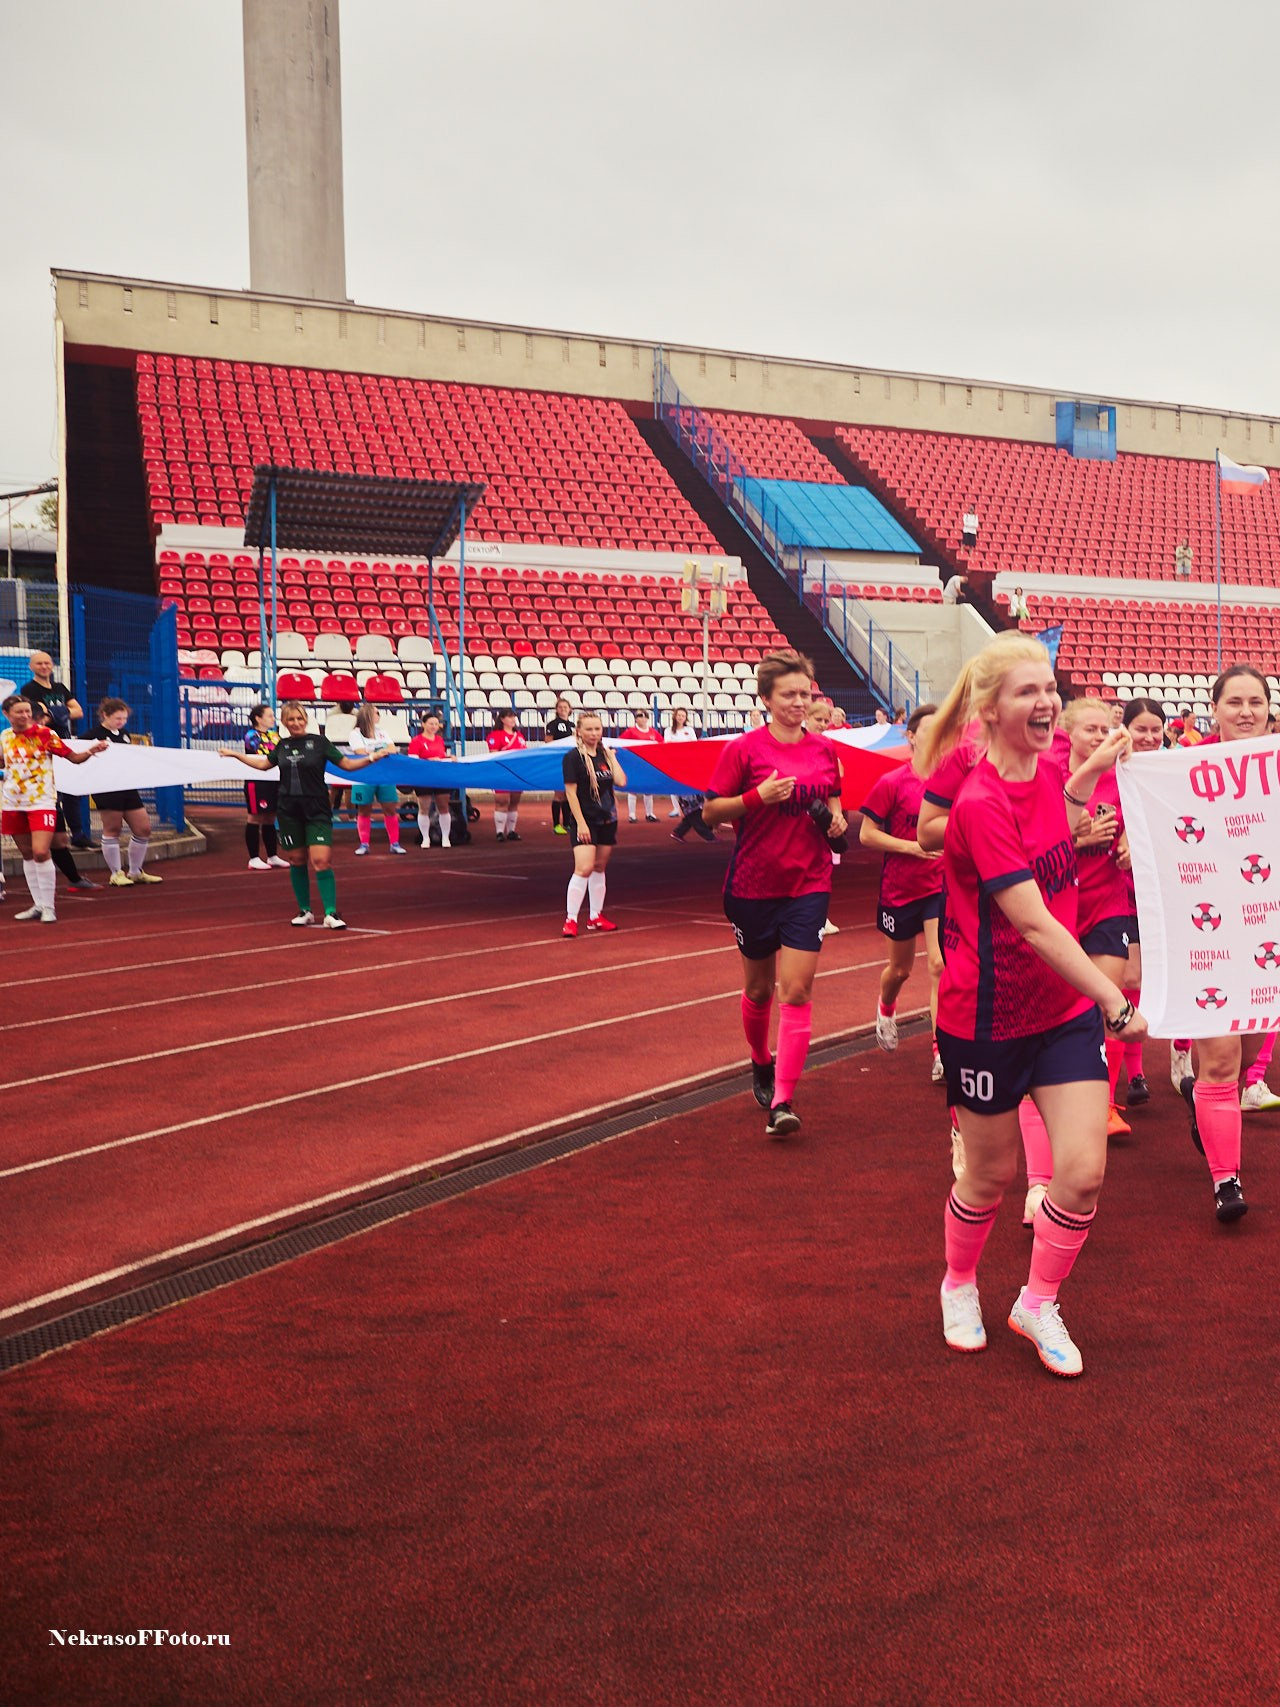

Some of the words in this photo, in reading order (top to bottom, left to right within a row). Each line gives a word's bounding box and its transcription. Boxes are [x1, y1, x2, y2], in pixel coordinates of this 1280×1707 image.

[1224, 812, 1267, 827] FOOTBALL
[1226, 826, 1250, 838] MOM!
[1177, 862, 1218, 874] FOOTBALL
[1180, 874, 1203, 885] MOM!
[882, 911, 896, 933] 88
[1243, 914, 1267, 926] MOM!
[1189, 950, 1231, 961] FOOTBALL
[1190, 961, 1213, 972] MOM!
[1251, 996, 1275, 1006] MOM!
[960, 1067, 994, 1101] 50
